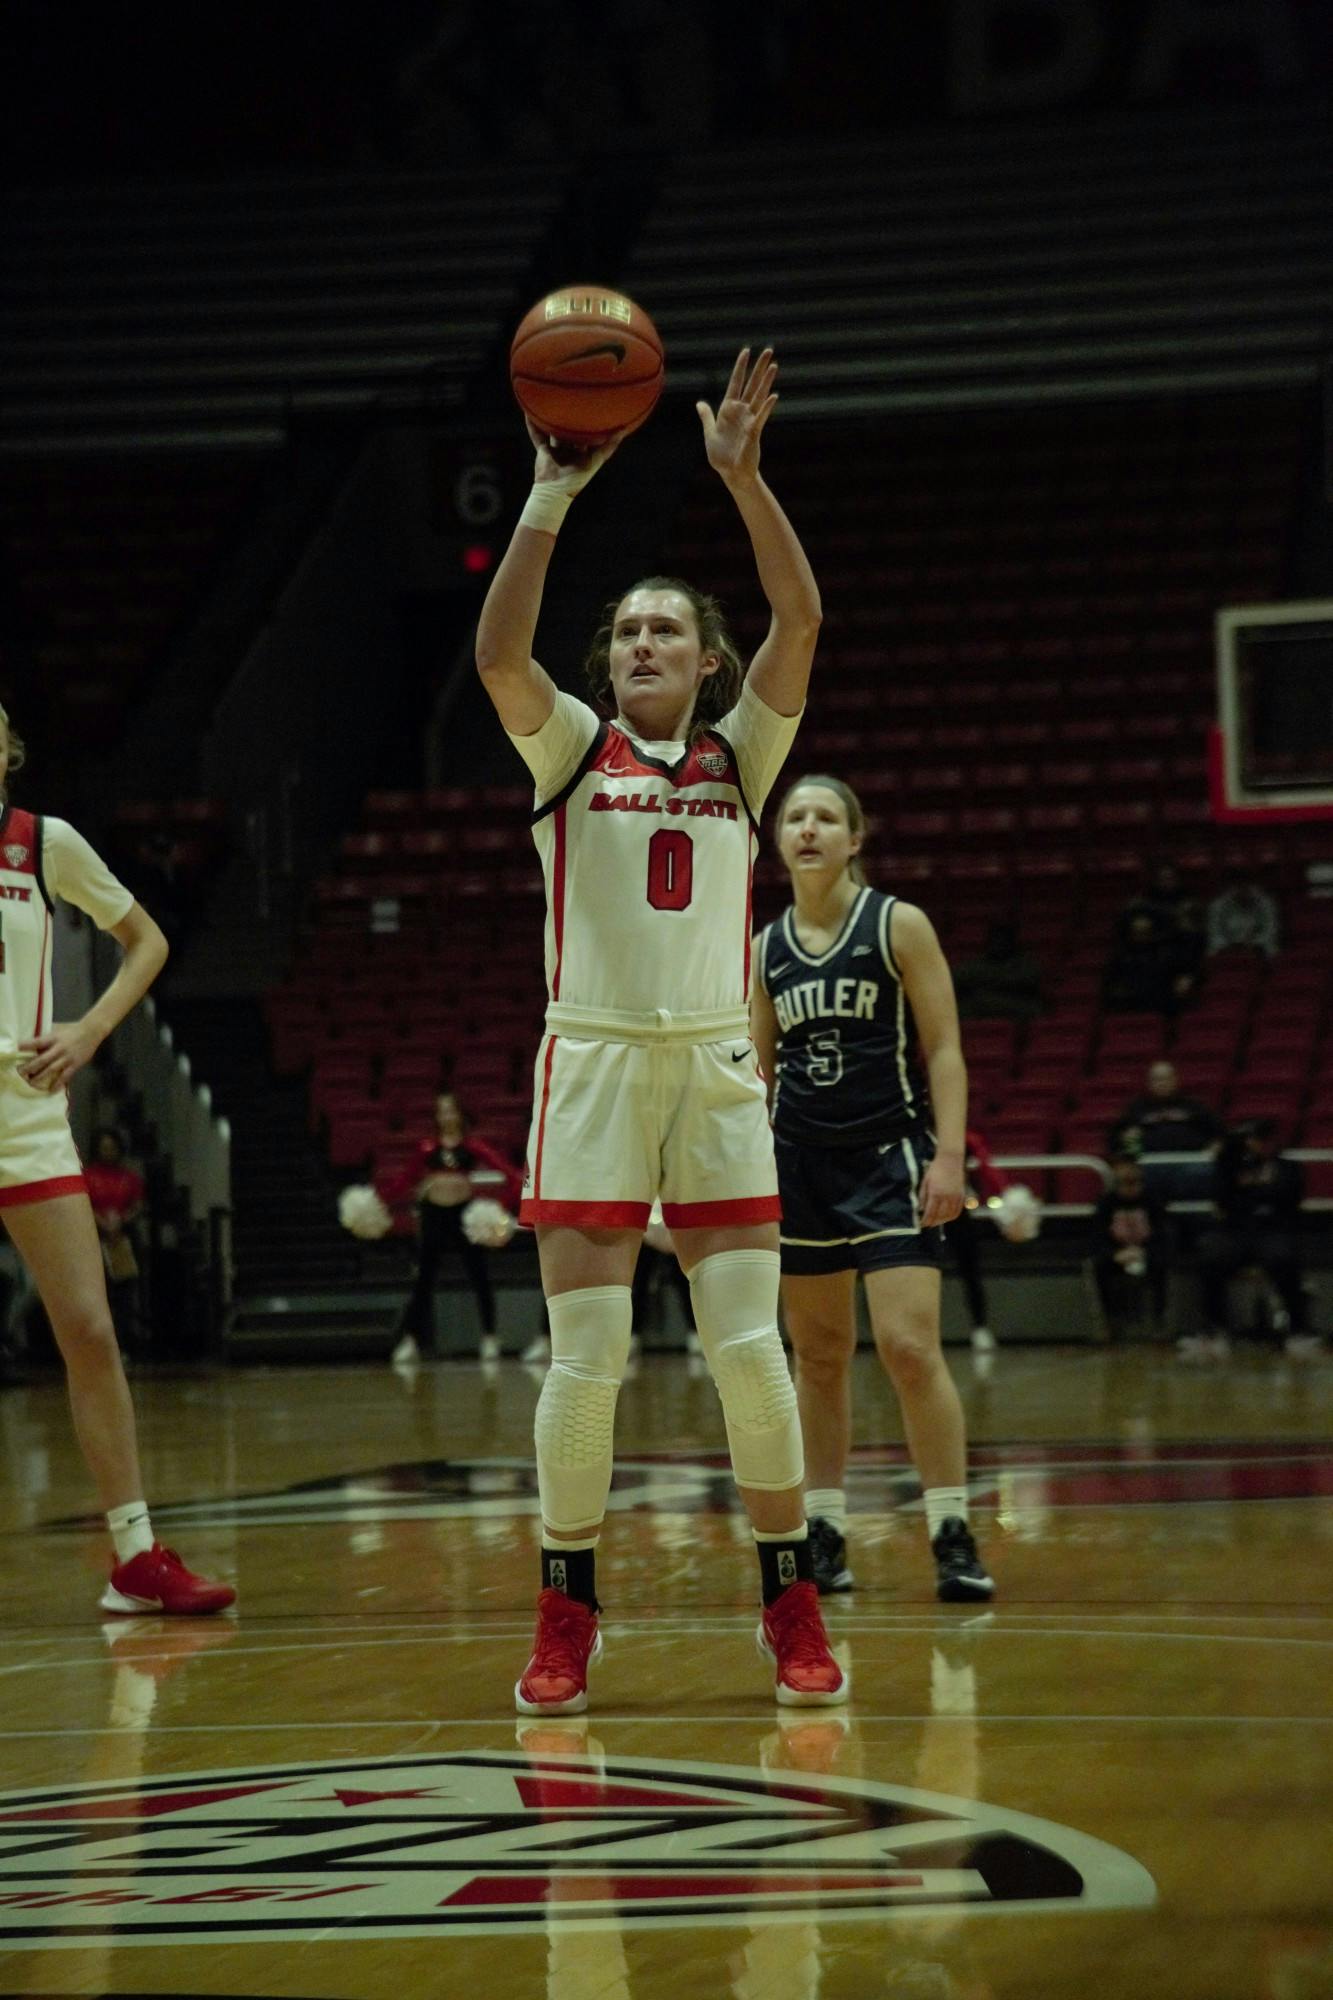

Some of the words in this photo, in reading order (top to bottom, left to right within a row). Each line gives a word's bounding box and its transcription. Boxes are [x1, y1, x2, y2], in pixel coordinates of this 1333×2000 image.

[454, 464, 503, 525] 6
[588, 792, 662, 812] BALL
[647, 829, 693, 911] 0
[773, 977, 880, 1034] BUTLER
[806, 1028, 844, 1086] 5
